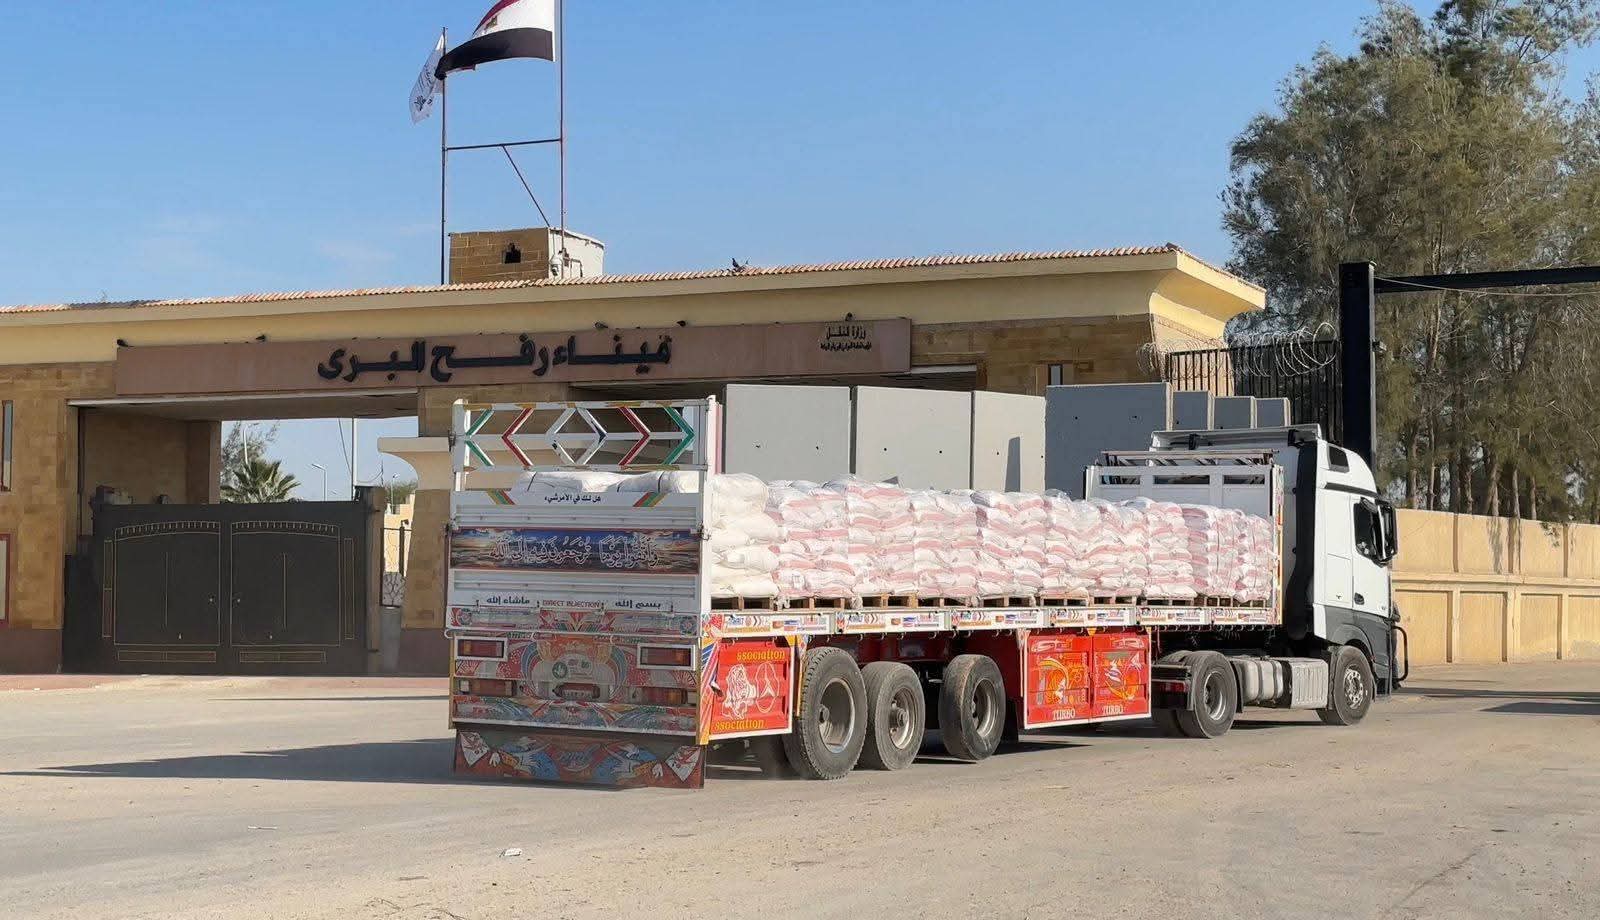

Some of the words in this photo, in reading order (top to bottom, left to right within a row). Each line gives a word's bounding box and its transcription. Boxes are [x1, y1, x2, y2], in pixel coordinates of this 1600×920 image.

[431, 332, 549, 382] رفح
[552, 334, 673, 375] ميناء
[635, 601, 661, 609] بسم
[1052, 708, 1076, 720] TURBO
[1102, 704, 1124, 715] TURBO
